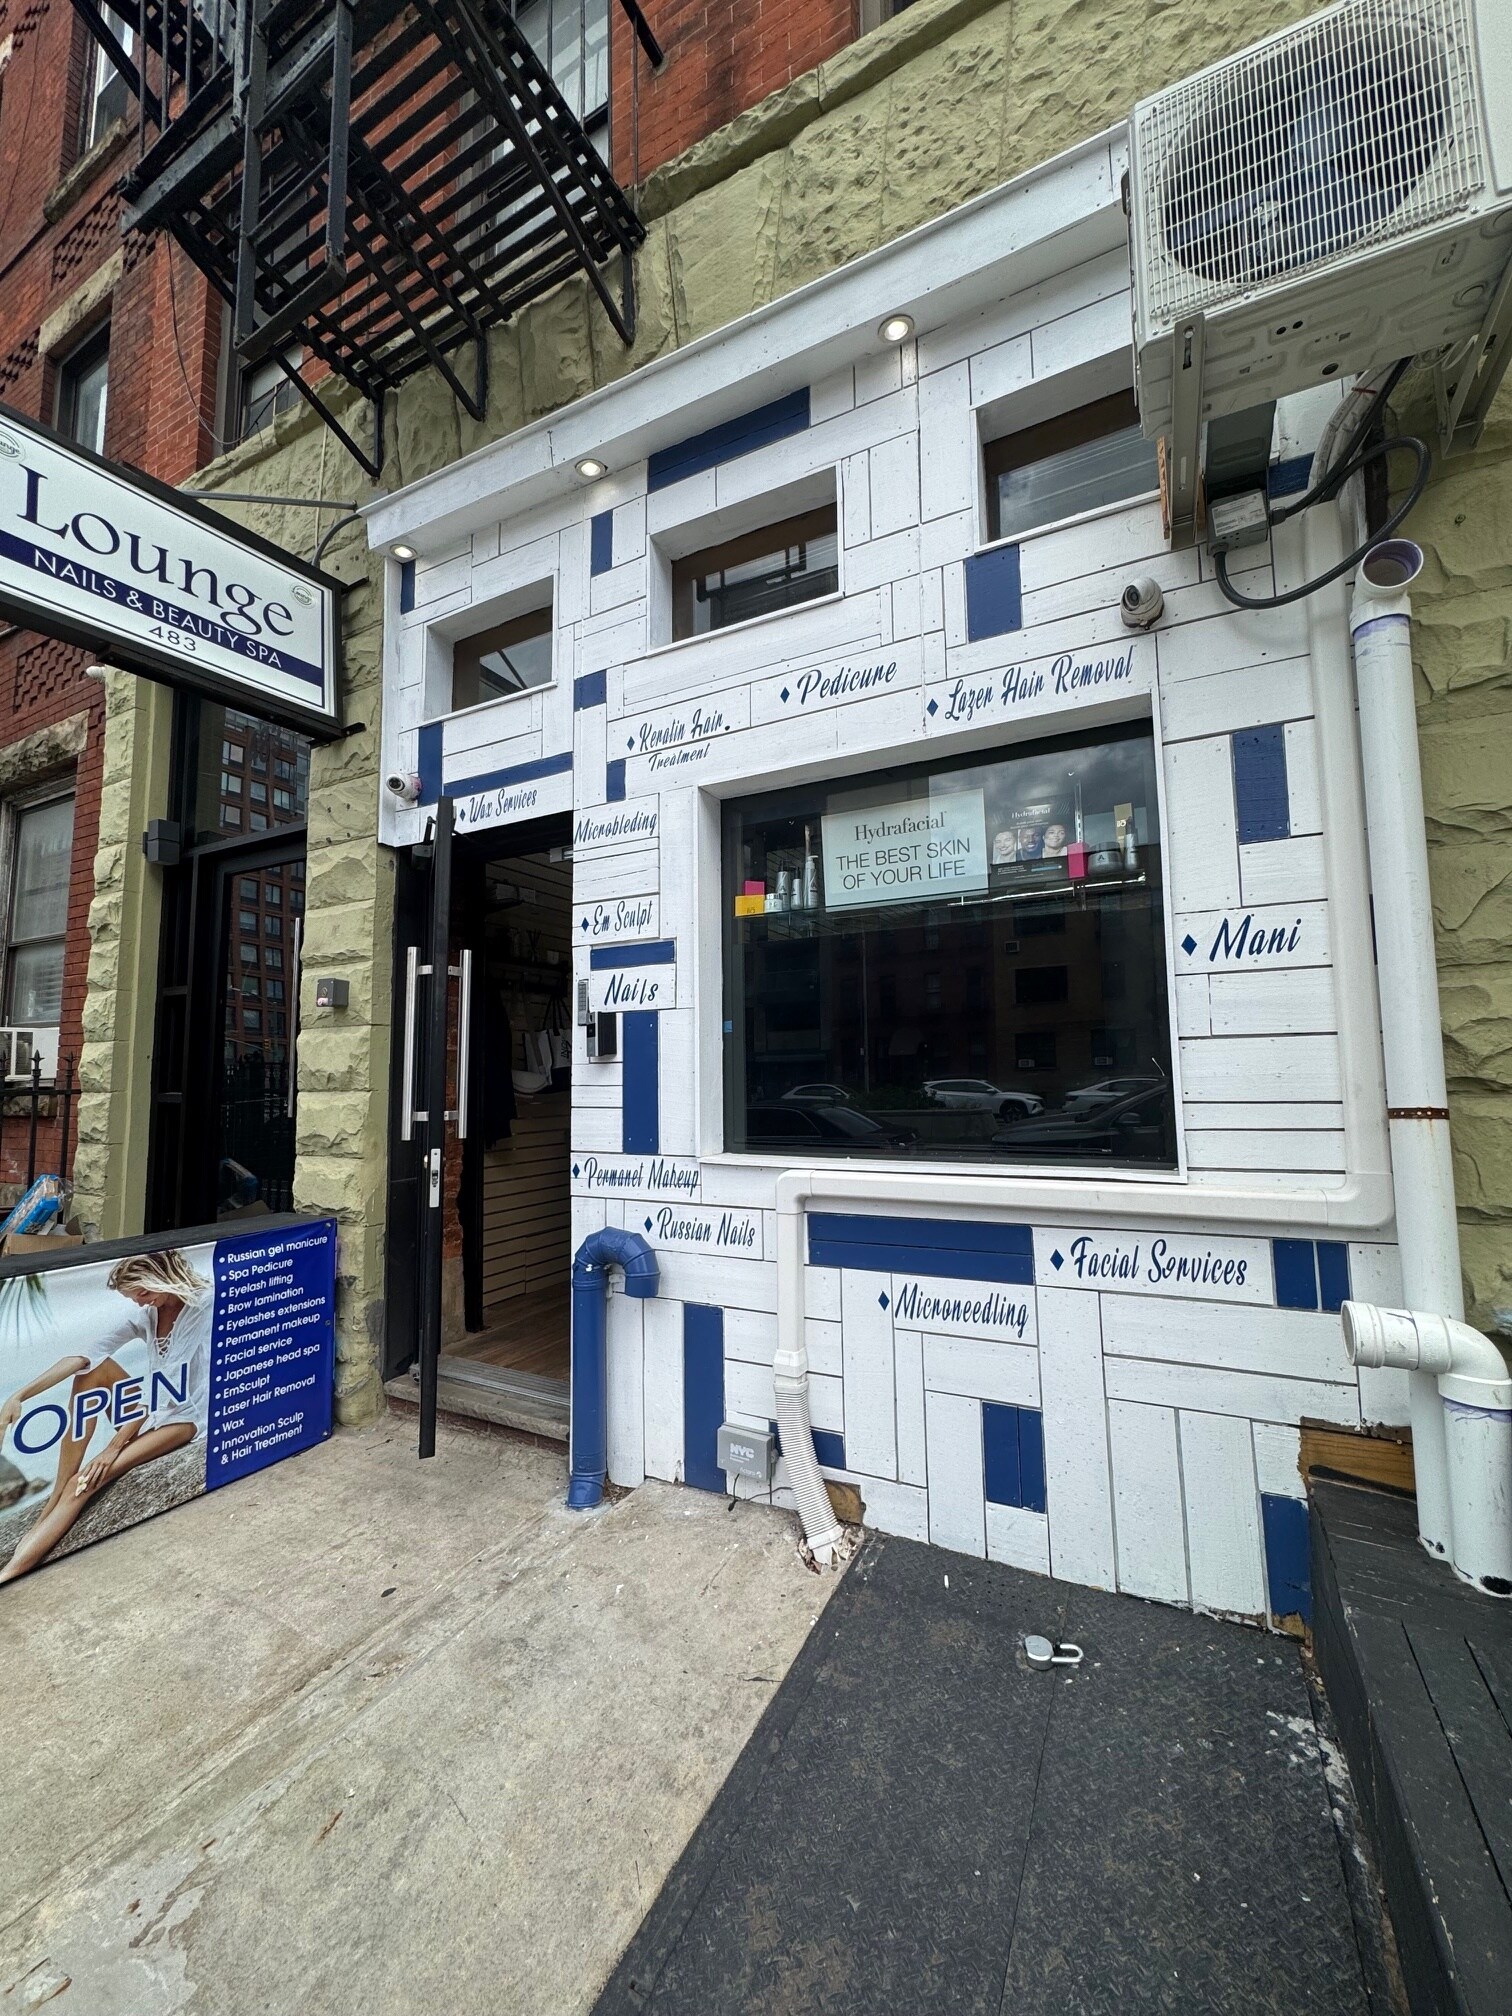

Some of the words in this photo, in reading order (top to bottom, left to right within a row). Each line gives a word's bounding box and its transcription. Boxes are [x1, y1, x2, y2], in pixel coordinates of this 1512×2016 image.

[17, 463, 294, 637] Lounge
[34, 549, 117, 599] NAILS
[127, 589, 144, 612] &
[153, 600, 240, 649] BEAUTY
[246, 640, 282, 669] SPA
[148, 626, 197, 652] 483
[797, 661, 898, 705] Pedicure
[945, 678, 994, 722] Lazer
[1000, 666, 1045, 706] Hair
[1051, 645, 1135, 696] Removal
[639, 719, 686, 752] Keratin
[691, 708, 724, 740] Hair
[648, 743, 711, 772] Treatment
[469, 795, 494, 824] Wax
[495, 787, 539, 818] Services
[574, 811, 658, 845] Microbleding
[853, 814, 946, 845] Hydrafacial
[836, 852, 871, 871] THE
[875, 844, 922, 866] BEST
[926, 837, 971, 859] SKIN
[843, 874, 867, 890] OF
[870, 865, 923, 885] YOUR
[927, 859, 967, 879] LIFE
[592, 904, 611, 936] Em
[614, 900, 653, 934] Sculpt
[1209, 914, 1302, 963] Mani
[603, 973, 659, 1006] Nails
[584, 1156, 644, 1190] Permanet
[647, 1158, 699, 1198] Makeup
[657, 1206, 712, 1241] Russian
[716, 1212, 755, 1248] Nails
[227, 1249, 267, 1264] Russian
[268, 1243, 285, 1258] gel
[286, 1236, 328, 1252] manicure
[1070, 1236, 1139, 1280] Facial
[1147, 1238, 1248, 1287] Services
[228, 1269, 250, 1281] Spa
[251, 1259, 294, 1276] Pedicure
[228, 1280, 267, 1298] Eyelash
[268, 1274, 294, 1288] lifting
[226, 1309, 276, 1331] Eyelashes
[277, 1296, 326, 1316] extensions
[227, 1300, 253, 1314] Brow
[254, 1286, 304, 1307] lamination
[895, 1282, 1029, 1340] Microneedling
[225, 1324, 280, 1347] Permanent
[281, 1313, 321, 1331] makeup
[223, 1358, 275, 1382] Japanese
[275, 1347, 302, 1365] head
[303, 1344, 321, 1356] spa
[224, 1346, 257, 1365] Facial
[257, 1337, 293, 1354] service
[222, 1398, 251, 1416] Laser
[252, 1390, 273, 1406] Hair
[273, 1374, 316, 1398] Removal
[223, 1374, 271, 1399] EmSculpt
[12, 1362, 189, 1455] OPEN
[222, 1417, 245, 1433] Wax
[221, 1422, 276, 1451] Innovation
[277, 1411, 304, 1428] Sculp
[221, 1453, 229, 1465] &
[231, 1445, 253, 1461] Hair
[254, 1423, 303, 1451] Treatment
[729, 1442, 755, 1459] NYC
